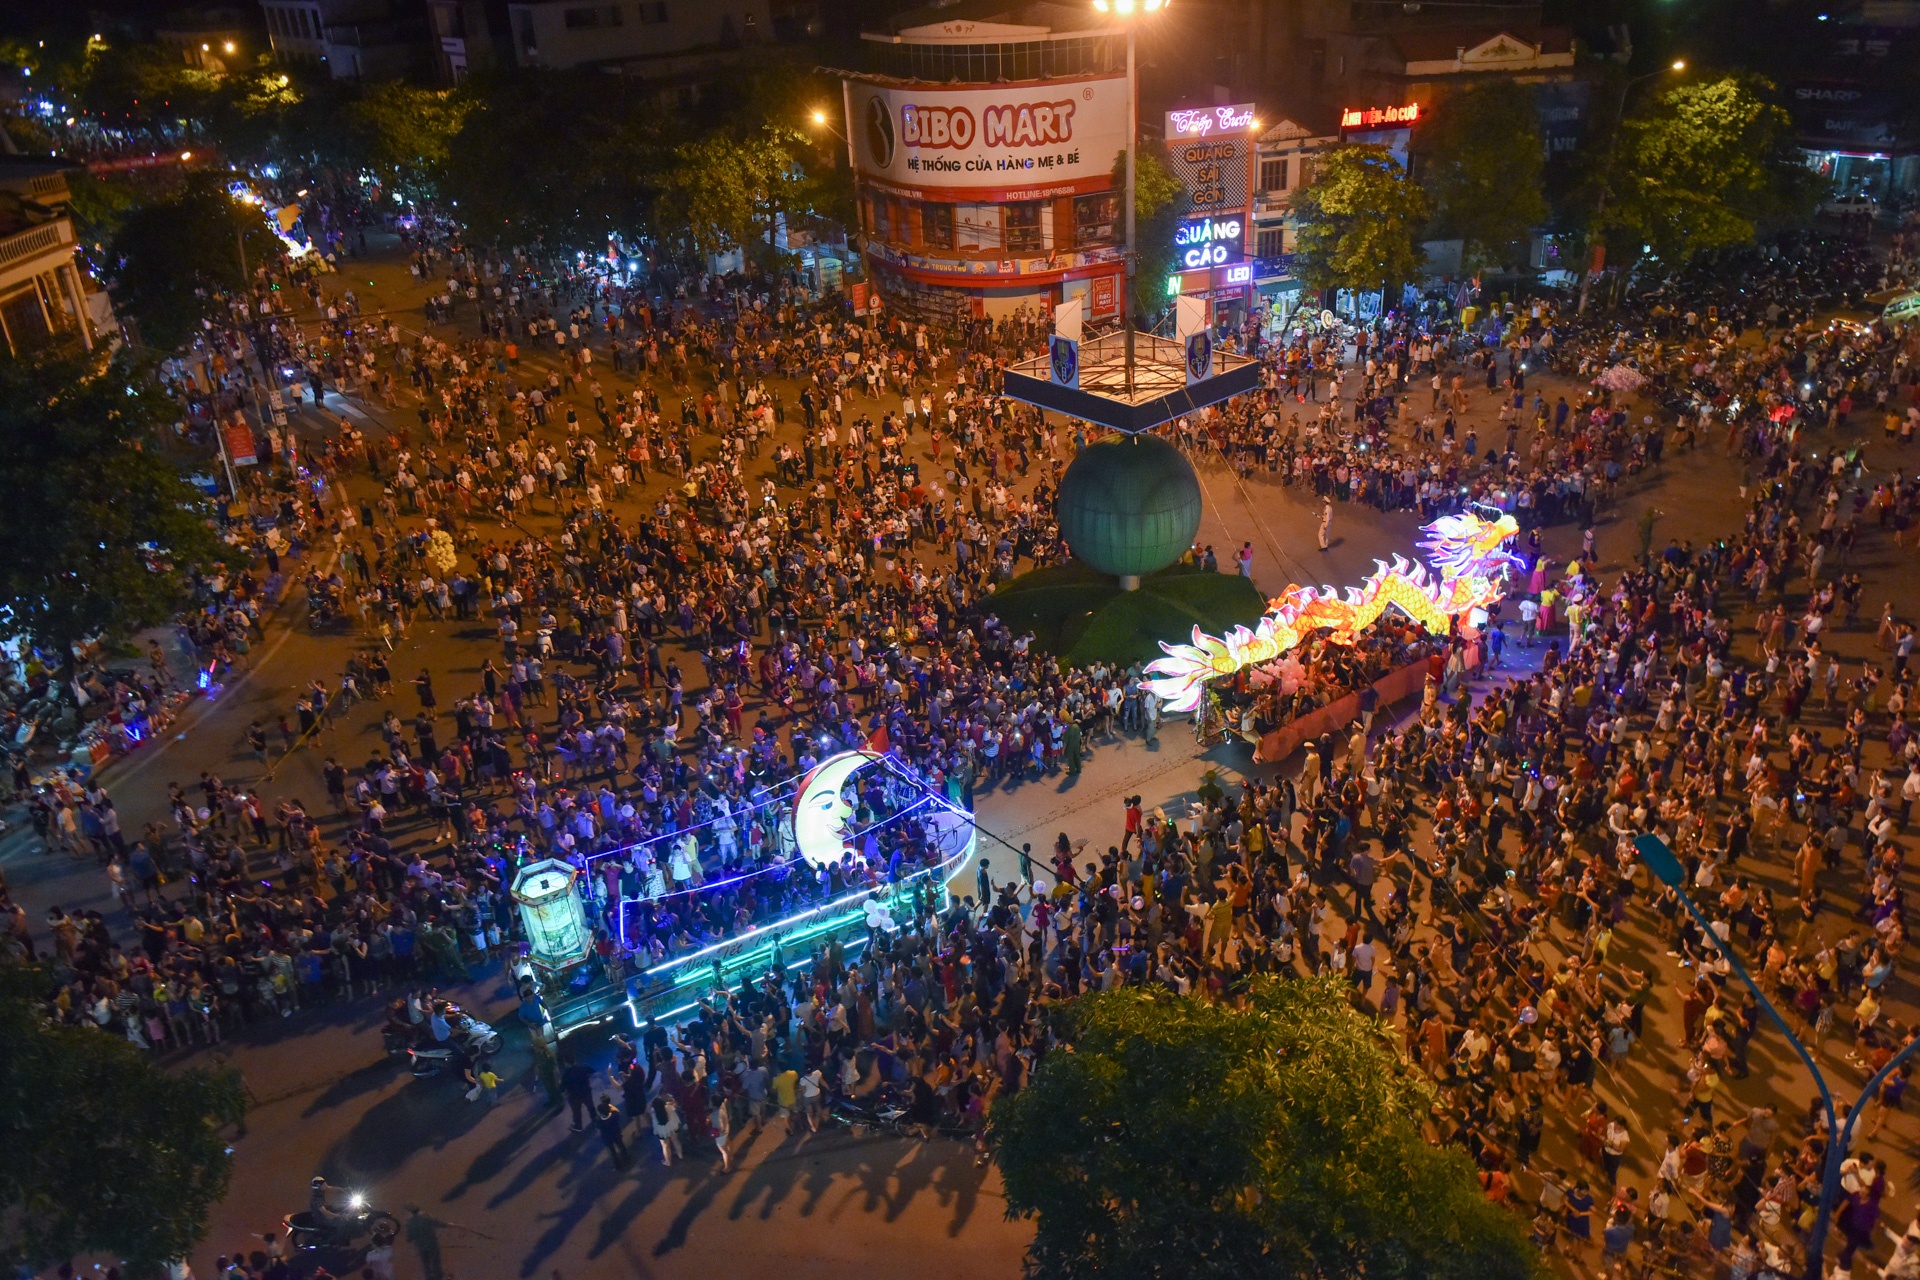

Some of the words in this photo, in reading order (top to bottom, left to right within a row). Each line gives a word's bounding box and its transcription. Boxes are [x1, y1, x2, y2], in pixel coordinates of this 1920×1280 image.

[1795, 88, 1862, 101] SHARP
[902, 104, 975, 150] BIBO
[983, 98, 1075, 148] MART
[1216, 107, 1253, 130] Cưới
[908, 155, 920, 173] HỆ
[922, 155, 961, 172] THỐNG
[965, 154, 992, 172] CỦA
[1038, 155, 1054, 168] MẸ
[1056, 154, 1064, 165] &
[1067, 147, 1080, 164] BÉ
[1186, 145, 1234, 162] QUANG
[1175, 218, 1240, 244] QUẢNG
[1185, 242, 1228, 267] CÁO
[1167, 275, 1182, 295] IN
[1227, 266, 1250, 283] LED
